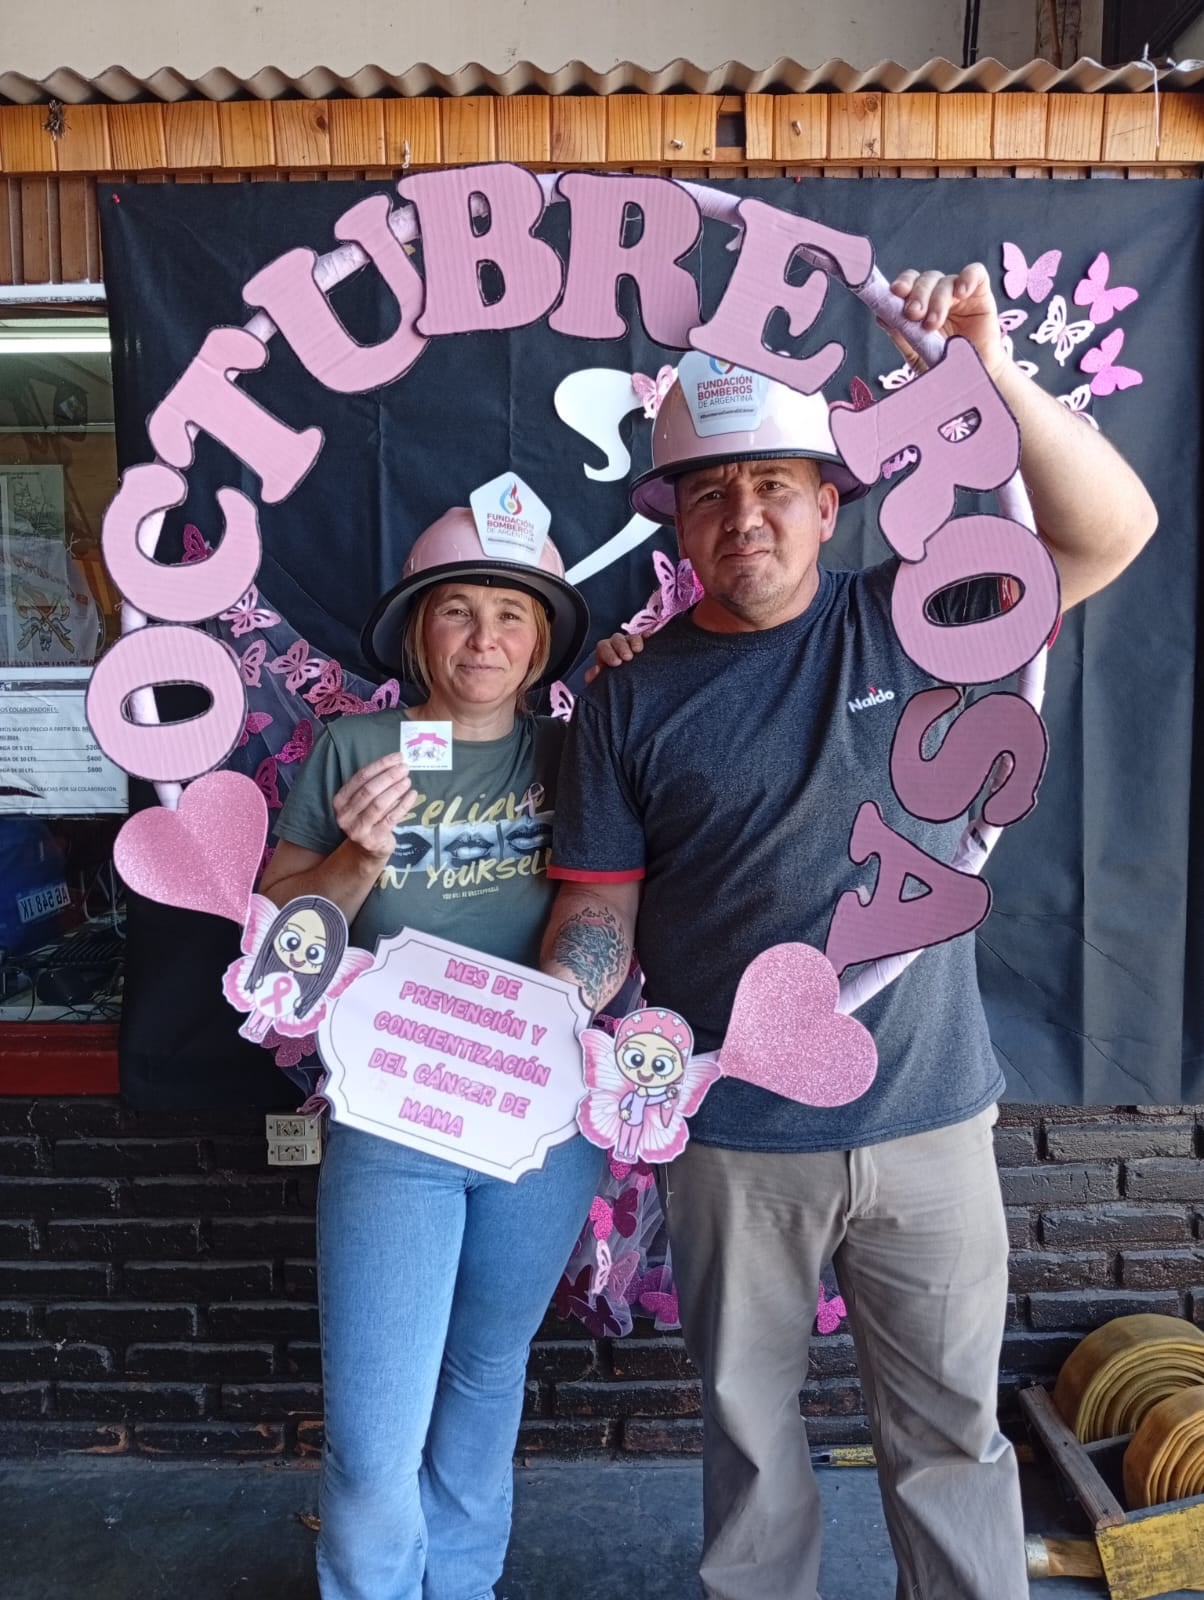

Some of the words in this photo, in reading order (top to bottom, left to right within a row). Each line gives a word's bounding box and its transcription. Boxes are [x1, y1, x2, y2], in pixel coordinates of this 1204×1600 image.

[697, 375, 753, 391] FUNDACIÓN
[697, 385, 753, 401] BOMBEROS
[698, 400, 708, 409] DE
[709, 395, 753, 406] ARGENTINA
[487, 512, 535, 530] FUNDACIÓN
[487, 520, 535, 537] BOMBEROS
[497, 528, 534, 543] ARGENTINA
[85, 161, 874, 782] OCTUBRE
[824, 335, 1061, 980] ROSA
[848, 689, 895, 713] Naldo
[444, 959, 490, 989] MES
[491, 975, 523, 1000] DE
[399, 981, 527, 1040] PREVENCIÓN
[531, 1024, 547, 1046] Y
[374, 1011, 551, 1087] CONCIENTIZACIÓN
[368, 1048, 407, 1078] DEL
[413, 1063, 496, 1106] CÁNCER
[499, 1092, 531, 1119] DE
[399, 1097, 464, 1138] MAMA
